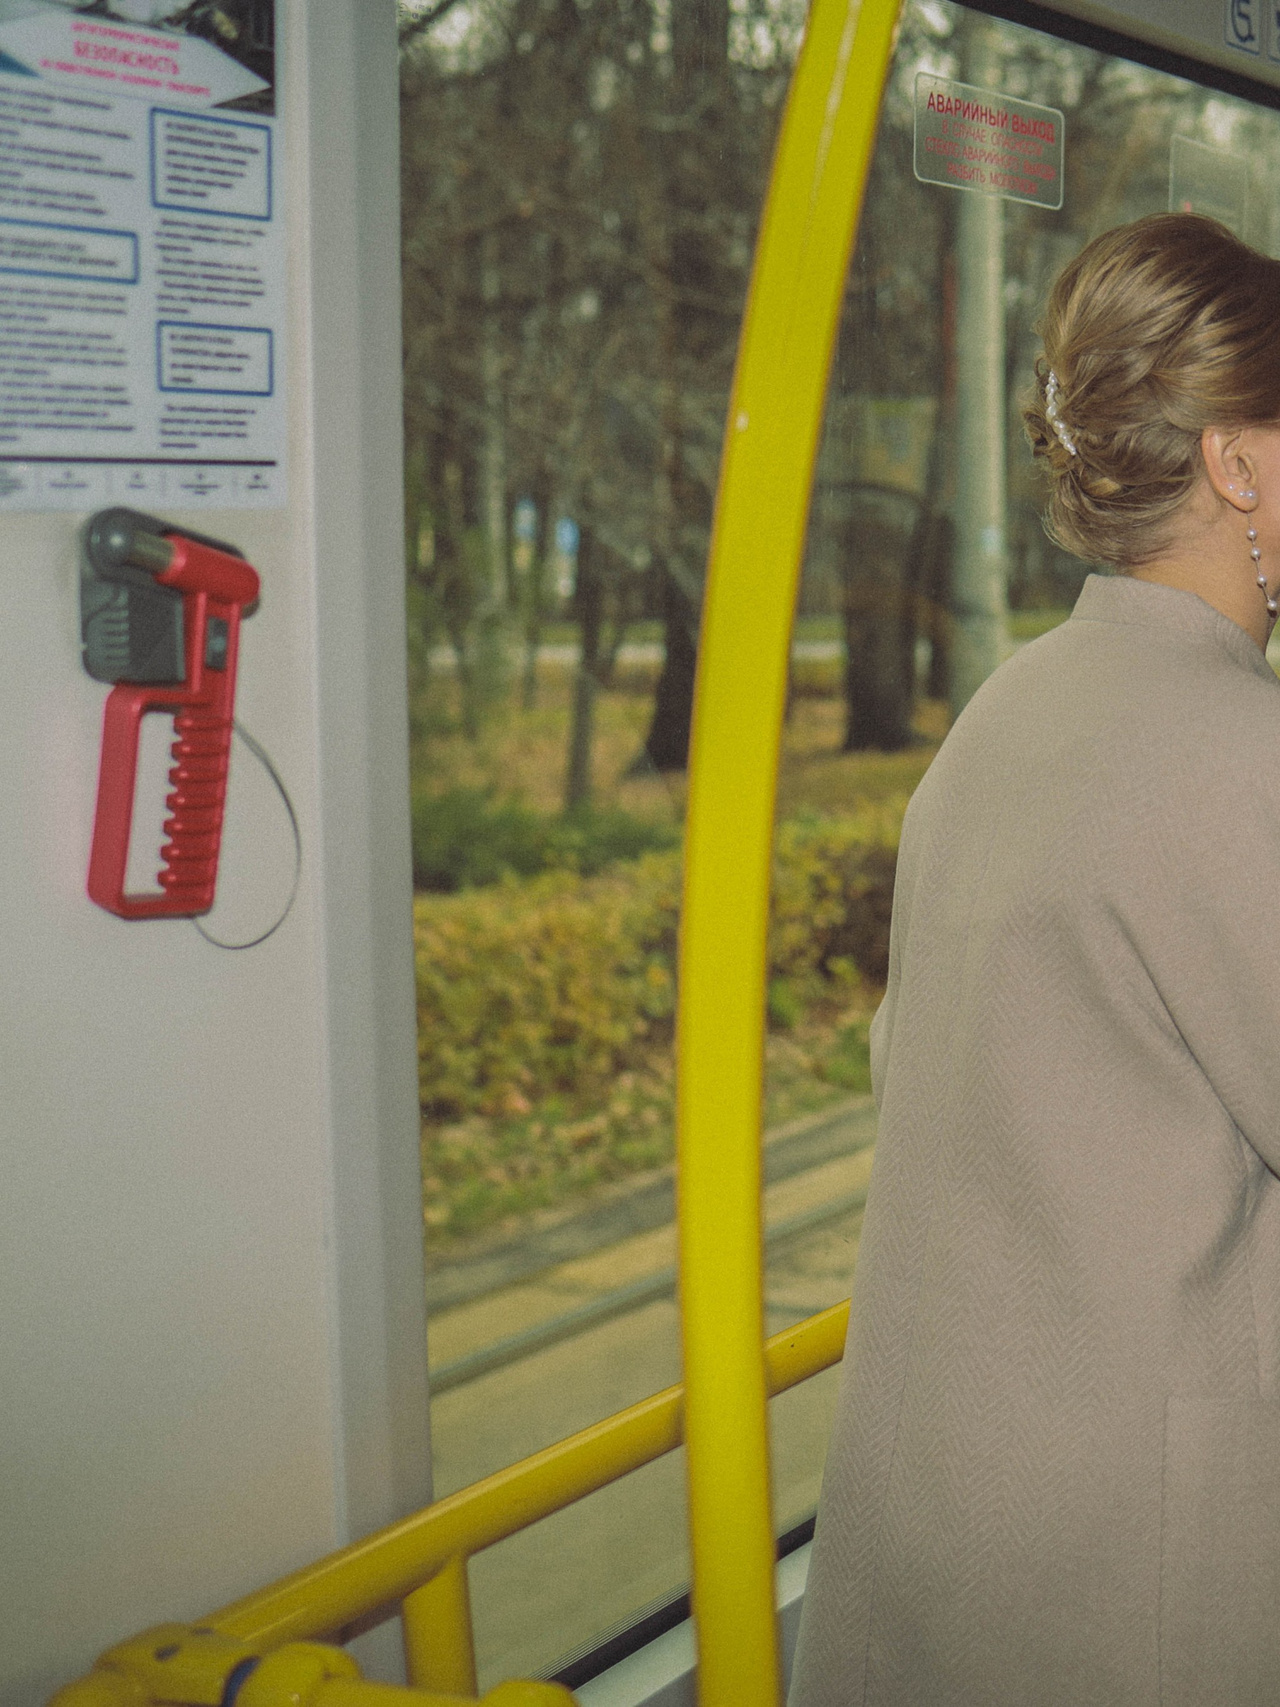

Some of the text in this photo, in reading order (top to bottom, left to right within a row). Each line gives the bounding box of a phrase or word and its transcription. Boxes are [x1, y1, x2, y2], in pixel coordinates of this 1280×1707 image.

[927, 91, 1056, 144] АВАРИЙНЫЙ ВЫХОД
[941, 119, 949, 134] В
[952, 122, 987, 144] СЛУЧАЕ
[924, 136, 960, 158] СТЕКЛО
[962, 145, 1019, 172] АВАРИЙНОГО
[946, 161, 986, 183] РАЗБИТЬ
